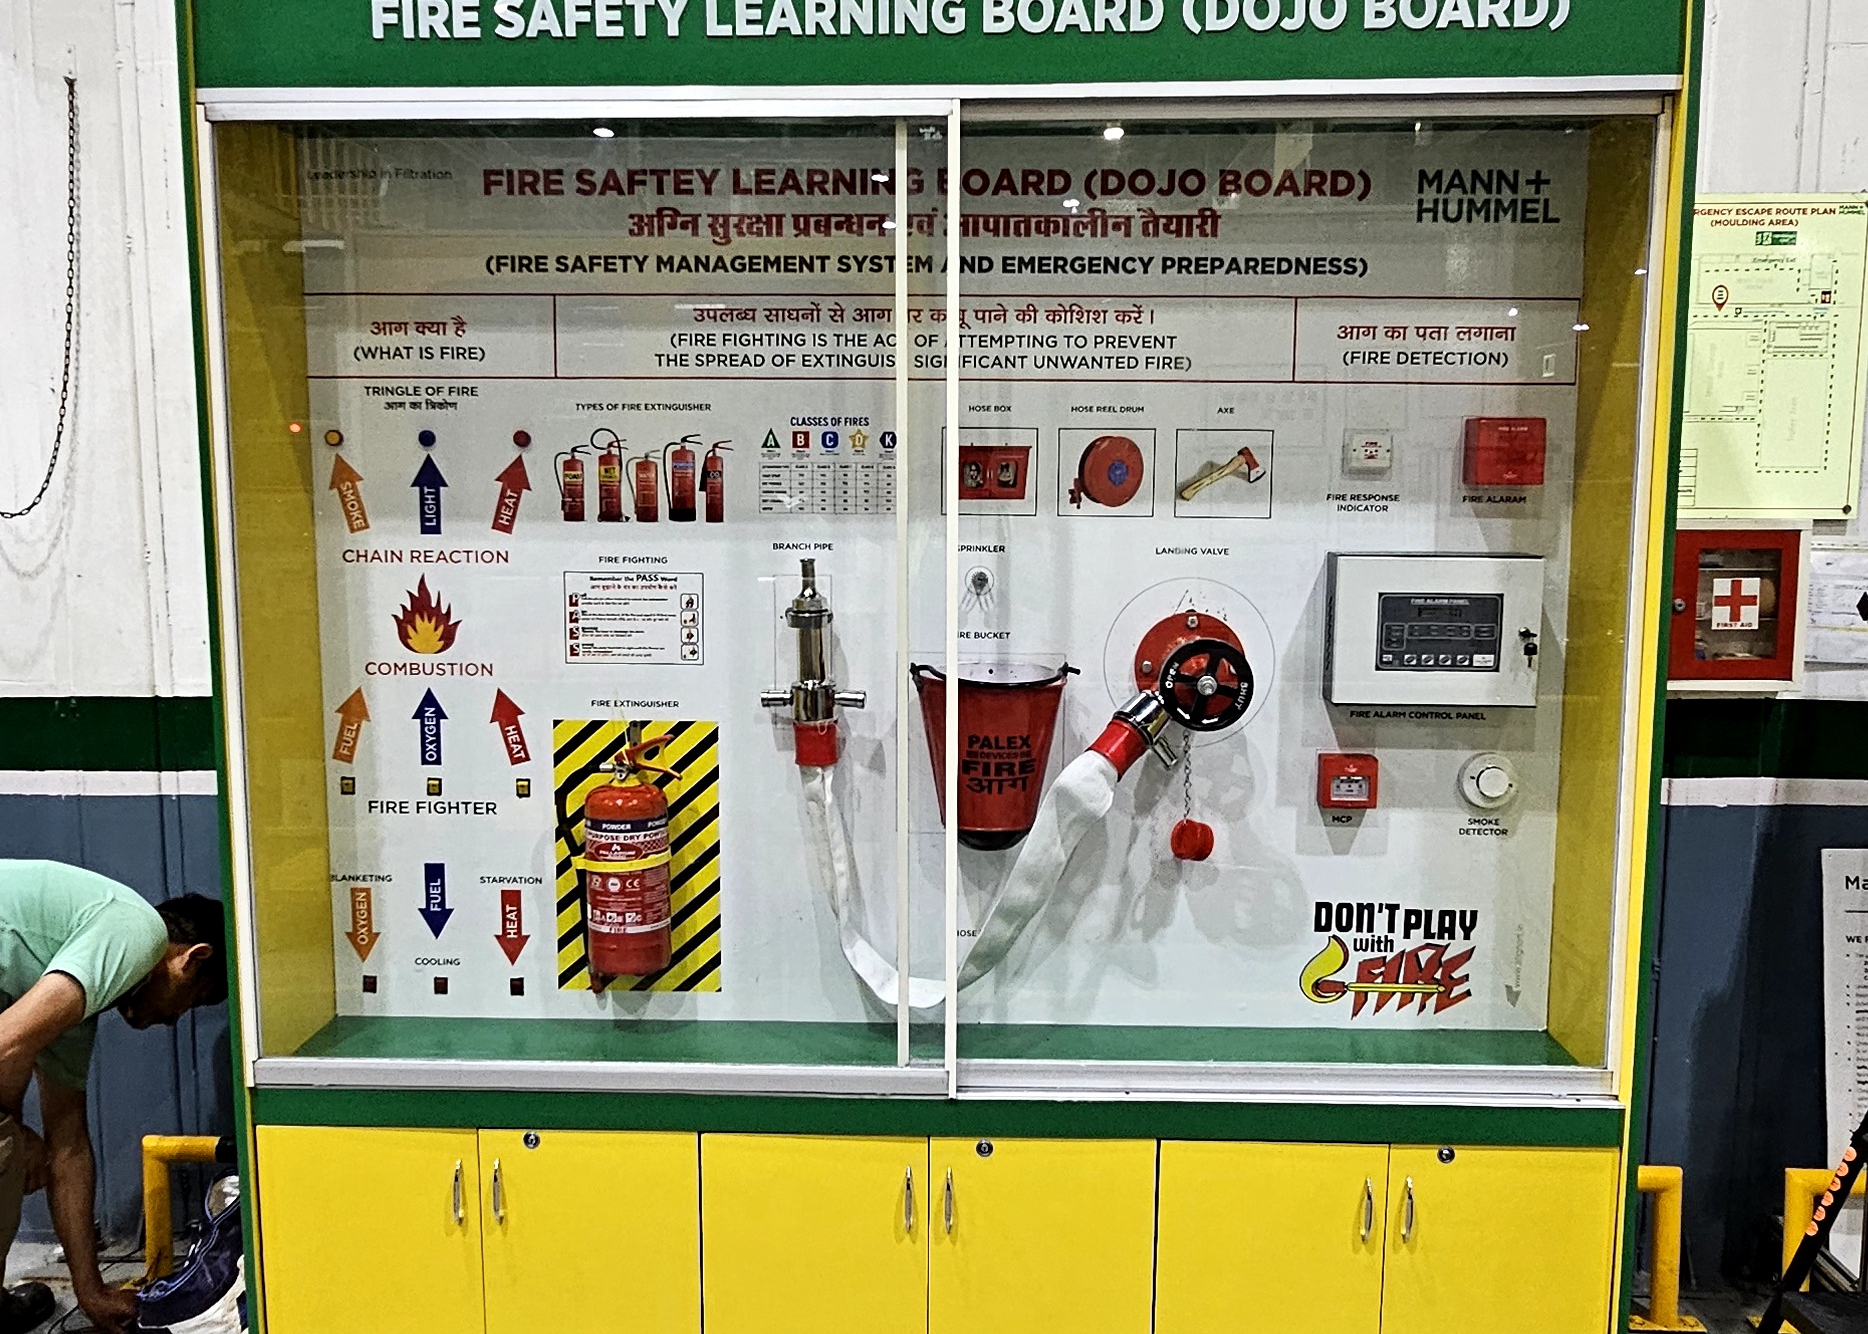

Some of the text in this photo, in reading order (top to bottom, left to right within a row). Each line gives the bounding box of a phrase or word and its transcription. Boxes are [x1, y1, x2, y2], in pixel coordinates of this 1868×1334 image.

[483, 168, 564, 196] FIRE
[575, 168, 720, 196] SAFTEY
[732, 167, 924, 196] LEARNING
[1084, 168, 1206, 200] (DOJO
[1218, 168, 1372, 201] BOARD)
[1416, 198, 1560, 224] HUMMEL
[1736, 208, 1836, 216] ESCAPE ROUTE PLAN
[628, 206, 1222, 246] अग्नि सुरक्षा प्रबन्धन तैयारी
[1710, 218, 1799, 227] (MOULDING AREA)
[486, 255, 548, 275] (FIRE
[555, 255, 647, 274] SAFETY
[656, 255, 831, 274] MANAGEMENT
[837, 255, 933, 274] SYSTEM
[1001, 255, 1154, 274] EMERGENCY
[1161, 255, 1369, 278] PREPAREDNESS)
[694, 302, 1145, 324] उपलब्ध साधनों से आग पाने की कोशिश करें
[370, 315, 468, 338] आग क्या है
[1337, 325, 1517, 342] आग का पता लगाना
[670, 333, 1177, 349] (FIRE FIGHTING IS THE AC OF TTEMPTING TO PREVENT
[353, 346, 486, 363] (WHAT IS FIRE)
[1342, 351, 1509, 368] (FIRE DETECTION)
[655, 353, 1192, 372] THE SPREAD OF EXTINGUIS UNWANTED FIRE)
[364, 386, 479, 397] TRINGLE OF FIRE
[384, 398, 458, 411] आग का त्रिकोण
[576, 403, 711, 412] TYPES OF FIRE EXTINGUISHER
[968, 405, 1011, 413] HOSE BOX
[1071, 405, 1144, 413] HOSE REEL DRUM
[790, 417, 869, 427] CLASSES OF FIRES
[766, 434, 775, 447] A
[797, 433, 805, 446] B
[826, 433, 834, 446] C
[885, 433, 893, 446] K
[340, 481, 366, 530] SMOKE
[1326, 493, 1400, 503] FIRE RESPONSE
[1463, 495, 1527, 504] FIRE ALARAM
[424, 486, 436, 526] LIGHT
[498, 490, 519, 525] HEAT
[1337, 504, 1388, 513] INDICATOR
[773, 543, 834, 551] BRANCH PIPE
[1155, 547, 1229, 556] LANDING VALVE
[342, 549, 509, 564] CHAIN REACTION
[599, 556, 668, 564] FIRE FIGHTING
[636, 574, 659, 582] PASS
[365, 662, 493, 677] COMBUSTION
[1165, 661, 1180, 688] OPEN
[1234, 682, 1249, 710] SHUT
[591, 700, 679, 708] FIRE EXTINGUISHER
[1350, 710, 1486, 720] FIRE ALARM CONTROL PANEL
[340, 723, 358, 755] FUEL
[424, 707, 436, 762] OXYGEN
[505, 725, 525, 759] HEAT
[967, 734, 1031, 749] PALEX
[962, 758, 1036, 777] FIRE
[966, 776, 1030, 795] आग
[368, 800, 497, 815] FIRE FIGHTER
[1332, 815, 1352, 824] MCP
[1467, 818, 1500, 826] SMOKE
[1459, 828, 1508, 836] DETECTOR
[330, 874, 393, 882] BLANKETING
[480, 876, 542, 885] STARVATION
[430, 878, 442, 911] FUEL
[355, 891, 369, 945] OXYGEN
[506, 904, 518, 938] HEAT
[1314, 901, 1478, 940] DON'T PLAY
[1353, 934, 1394, 954] with
[1846, 935, 1862, 944] WE
[415, 957, 460, 966] COOLING
[1351, 942, 1476, 1020] FIRE
